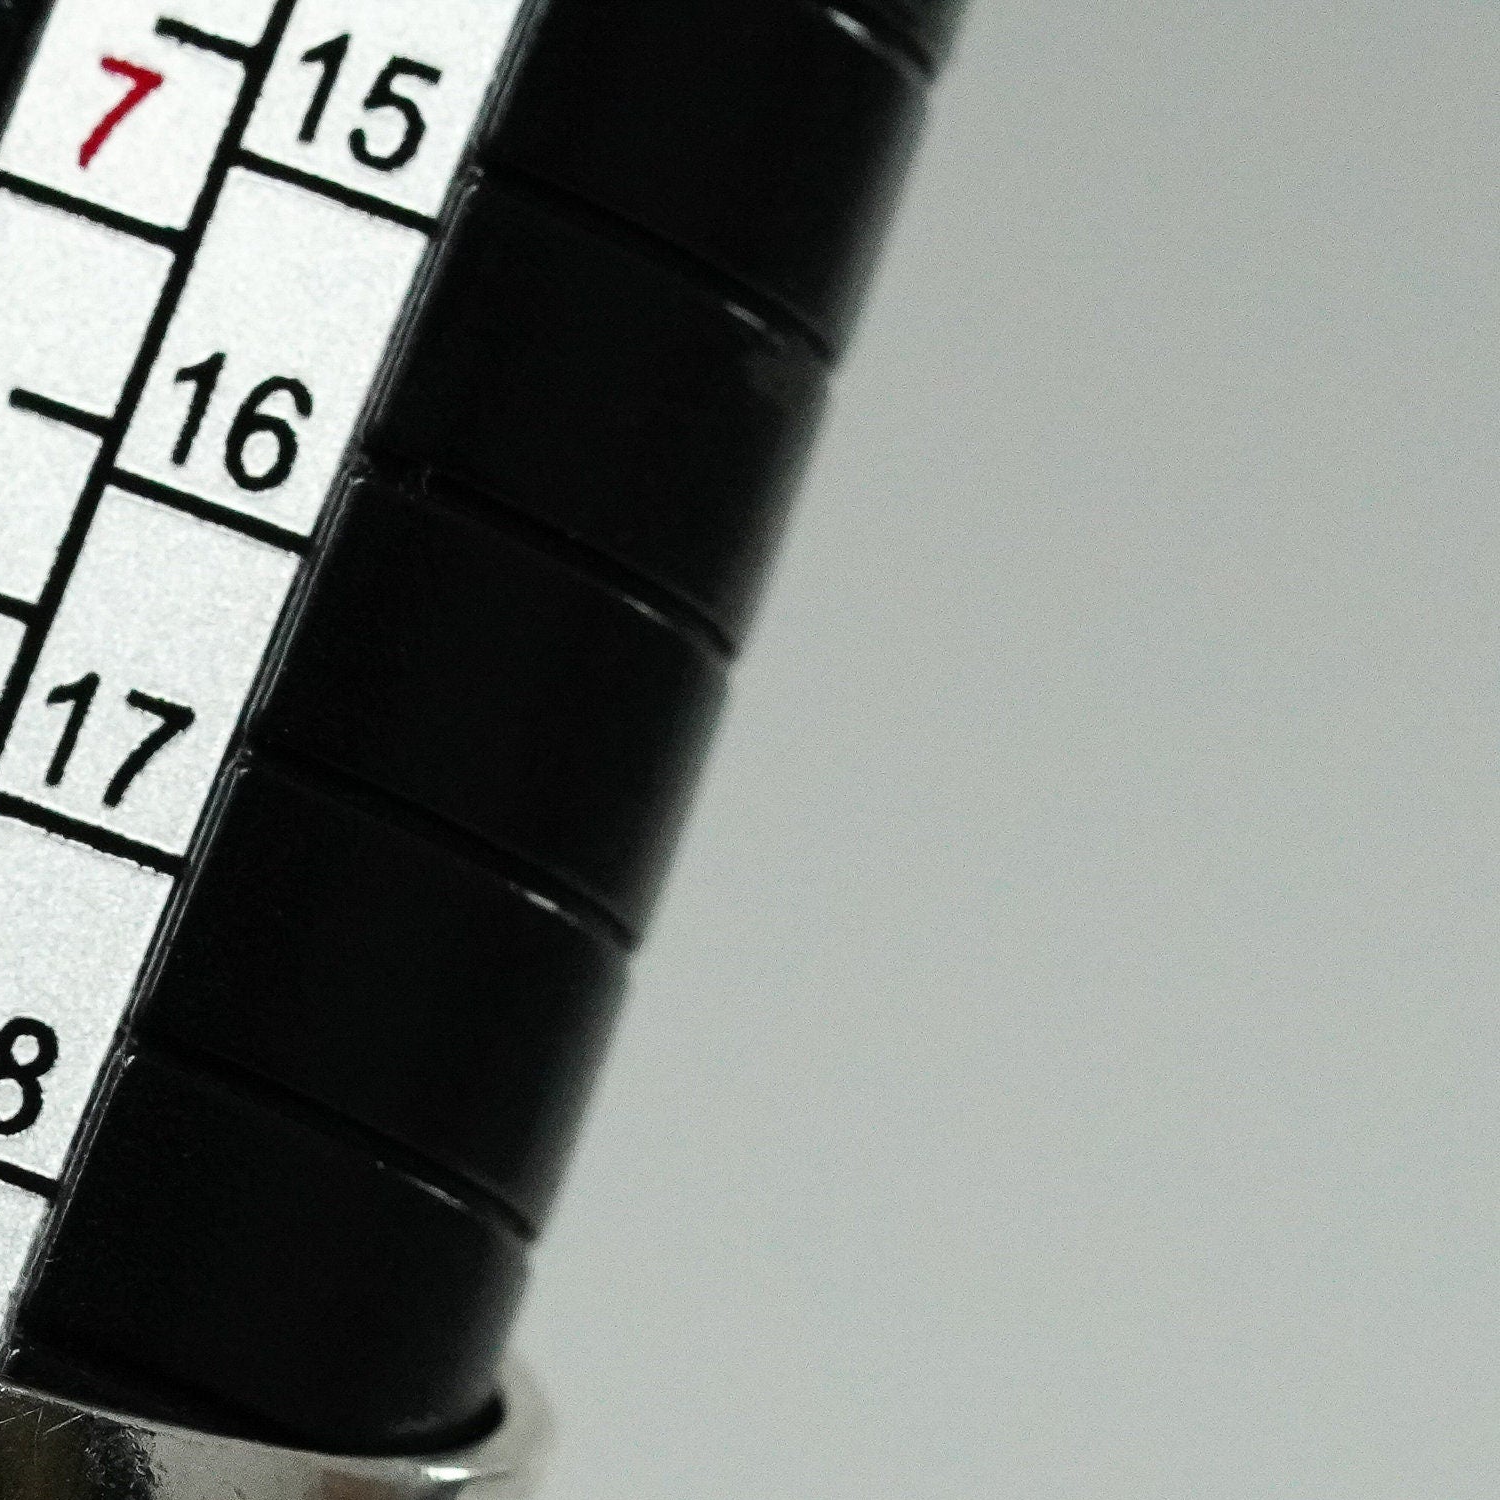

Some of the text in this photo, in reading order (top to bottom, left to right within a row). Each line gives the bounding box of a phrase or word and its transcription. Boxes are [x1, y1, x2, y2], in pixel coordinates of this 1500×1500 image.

[80, 57, 163, 168] 7
[298, 33, 442, 173] 15
[171, 352, 313, 493] 16
[45, 671, 196, 809] 17
